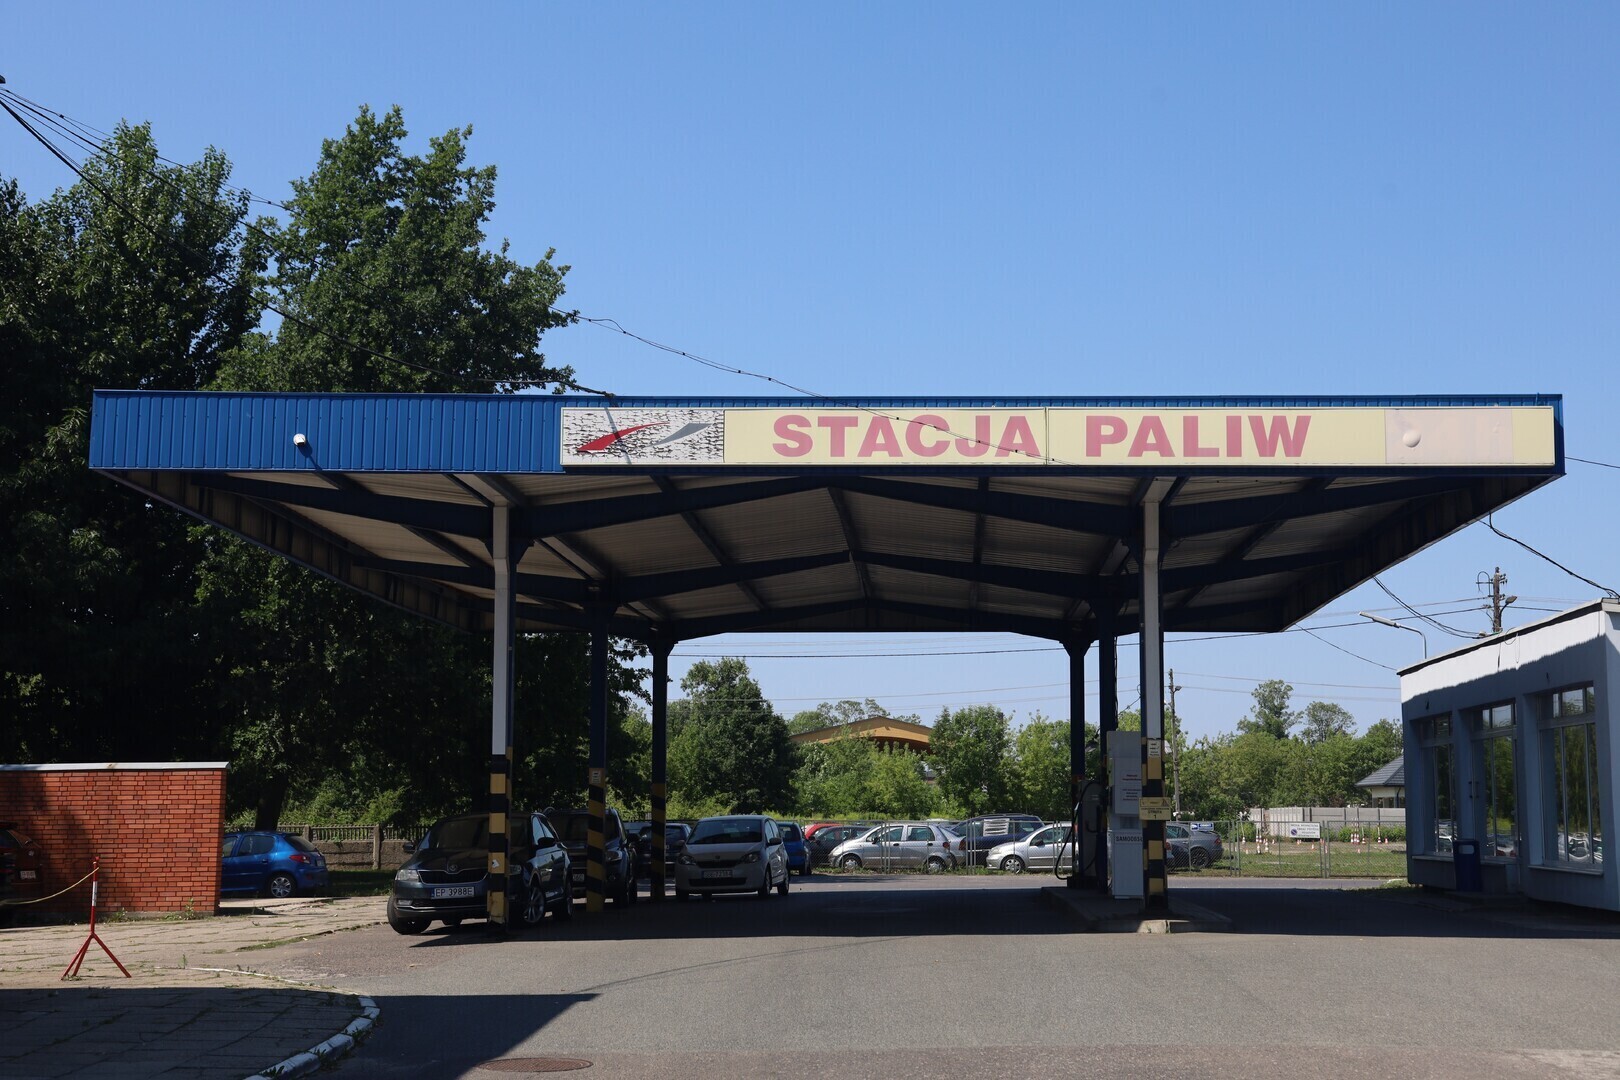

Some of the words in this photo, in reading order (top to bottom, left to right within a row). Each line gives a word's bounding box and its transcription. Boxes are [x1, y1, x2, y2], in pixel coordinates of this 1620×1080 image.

[773, 414, 1040, 457] STACJA
[1085, 415, 1311, 457] PALIW
[436, 888, 446, 897] EP
